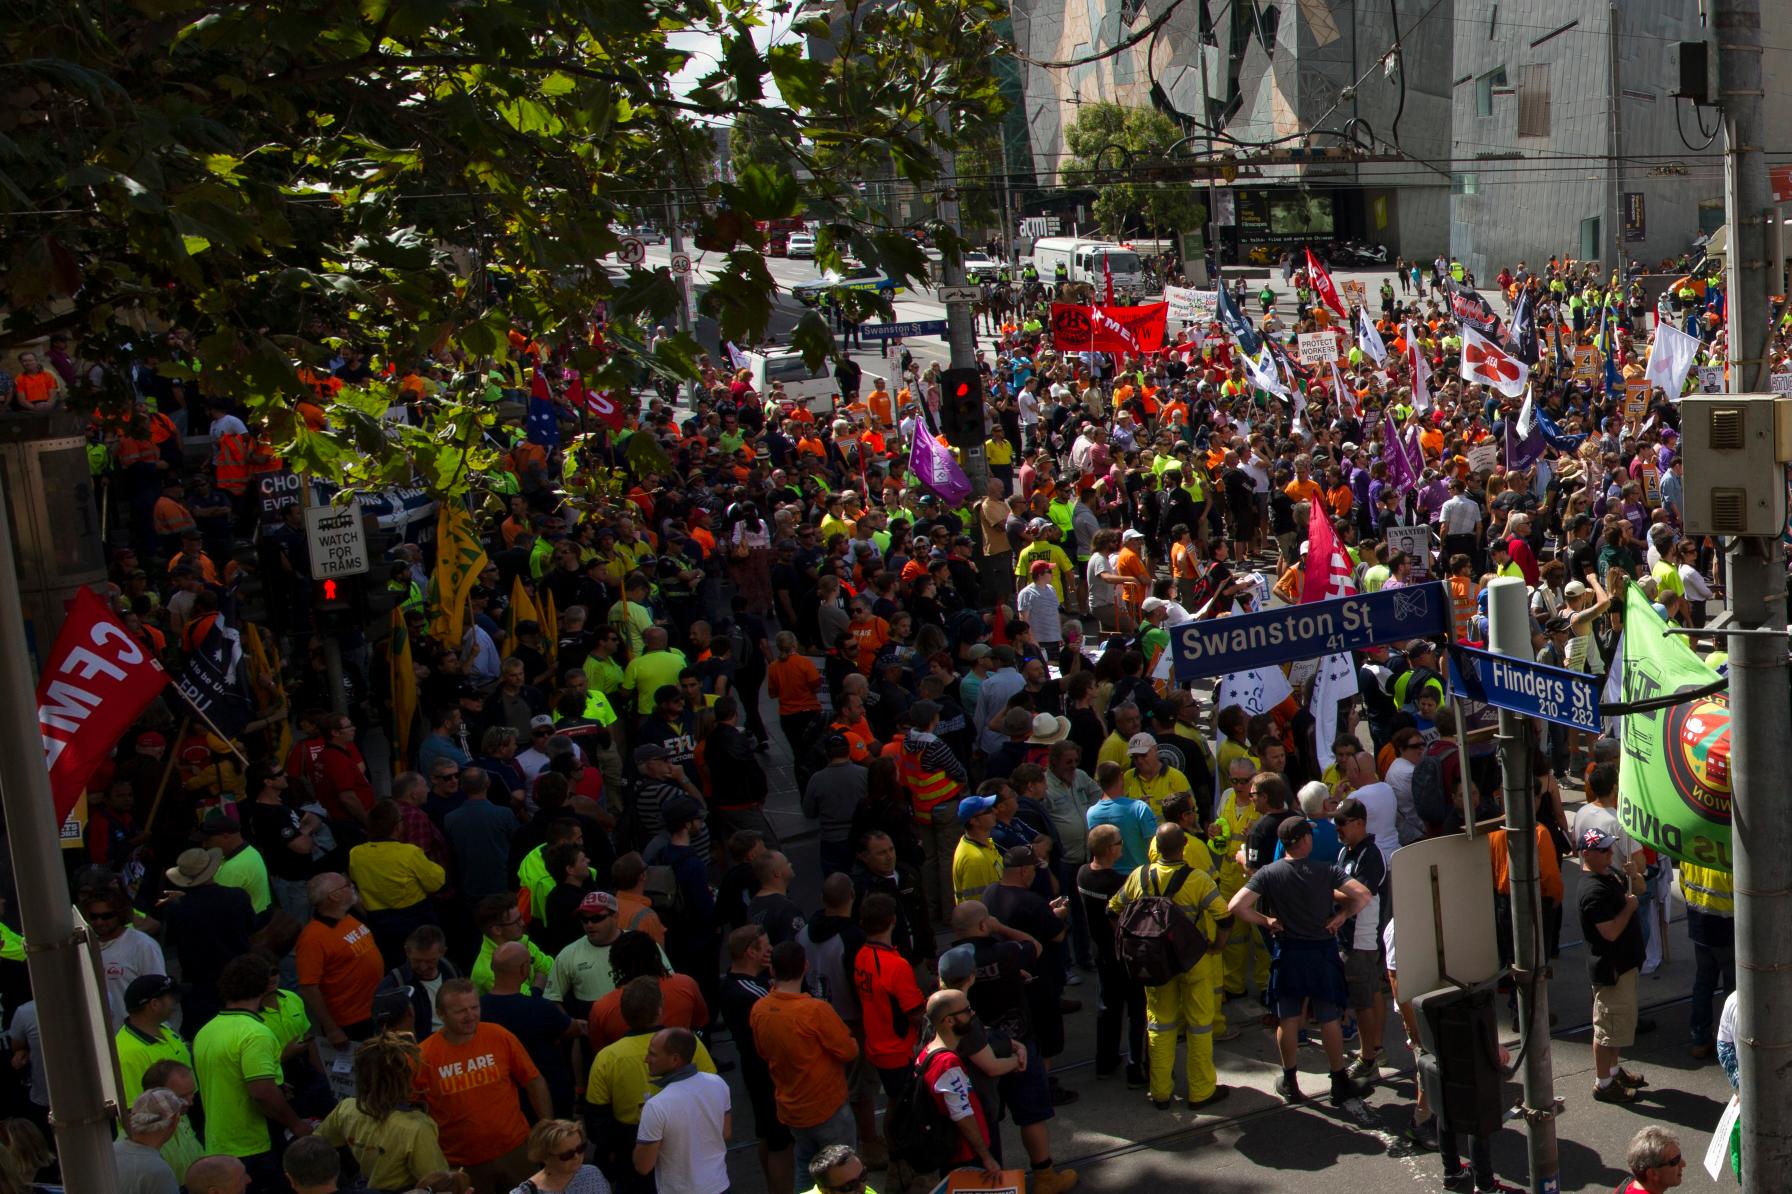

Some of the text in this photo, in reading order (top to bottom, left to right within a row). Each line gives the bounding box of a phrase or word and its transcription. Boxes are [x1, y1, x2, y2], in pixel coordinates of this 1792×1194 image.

[864, 324, 910, 336] Swanston
[912, 322, 921, 331] St
[1301, 338, 1334, 348] PROTECT
[319, 532, 358, 547] WATCH
[1388, 528, 1426, 538] UNWANTED
[329, 547, 352, 559] FOR
[321, 557, 363, 574] TRAMS
[1182, 600, 1372, 661] Swanston St
[1327, 633, 1345, 650] 41
[1365, 627, 1373, 643] 1
[1493, 662, 1593, 711] Flinders St
[1538, 698, 1558, 718] 210
[1572, 707, 1594, 728] 282
[438, 1053, 496, 1079] WE ARE
[439, 1065, 501, 1097] UNION
